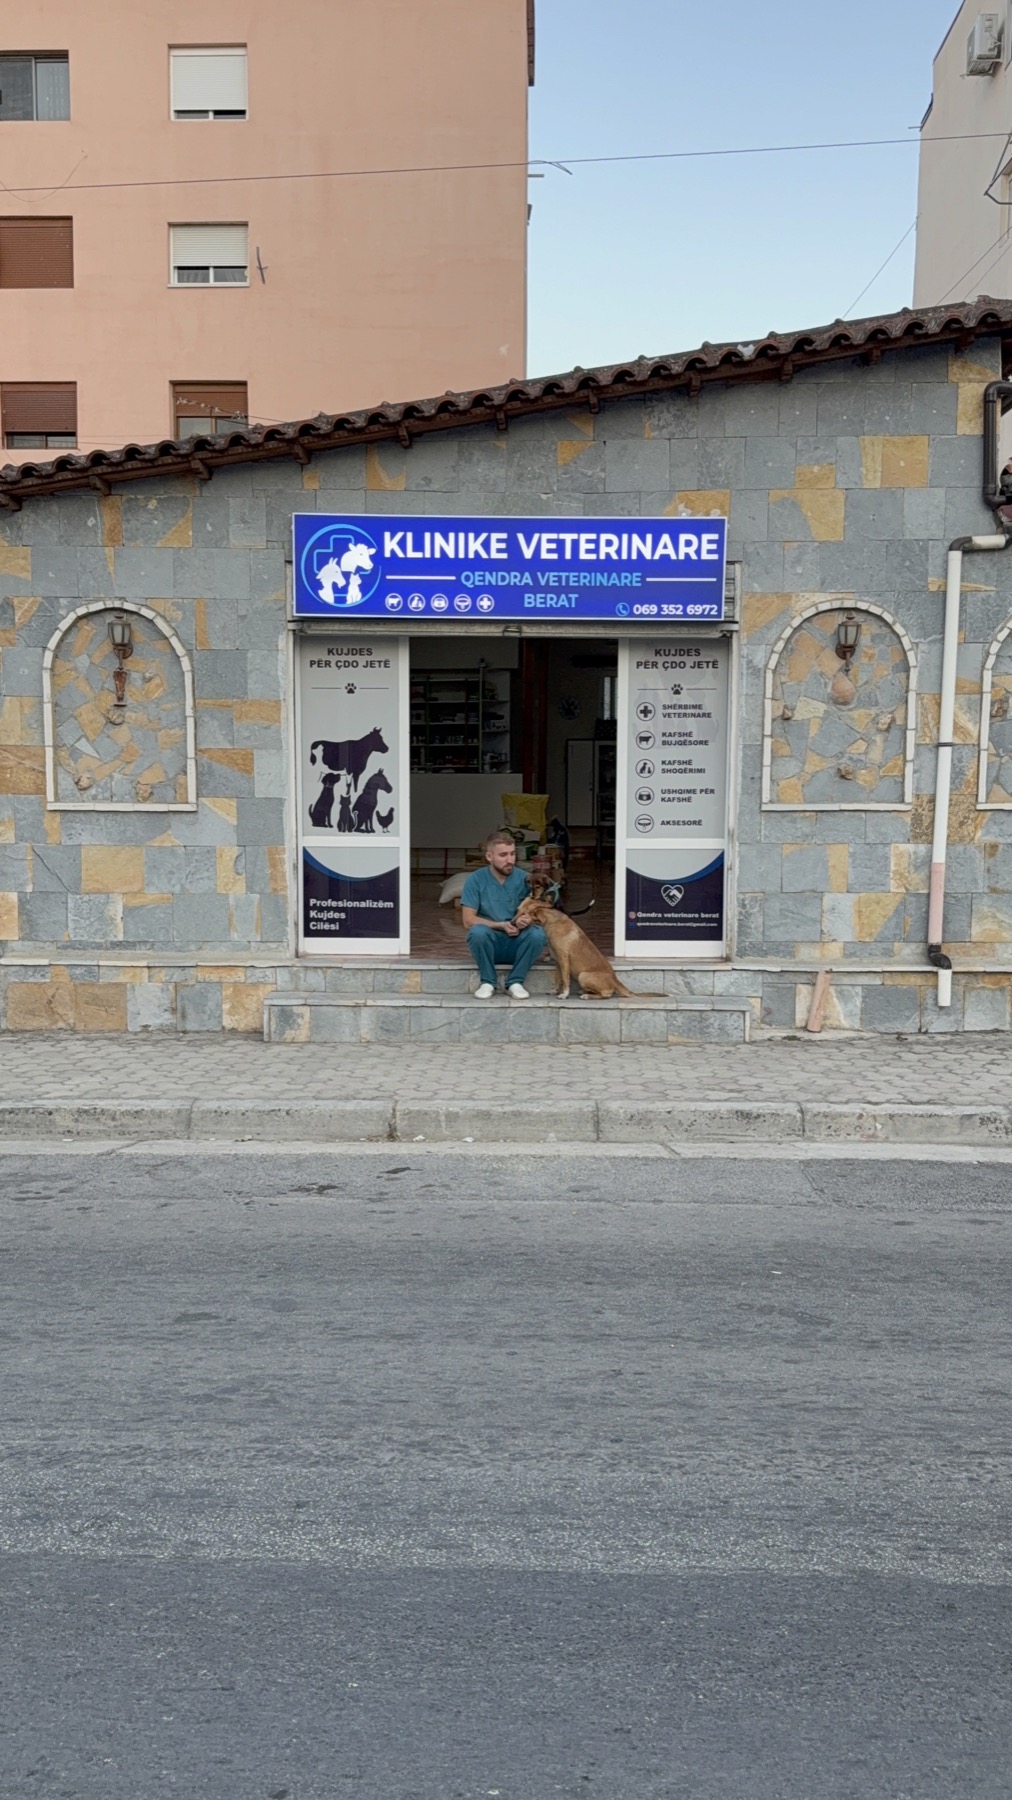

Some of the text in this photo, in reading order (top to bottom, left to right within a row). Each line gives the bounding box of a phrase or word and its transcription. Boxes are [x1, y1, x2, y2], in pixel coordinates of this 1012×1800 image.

[383, 531, 719, 560] KLINIKE VETERINARE
[460, 571, 642, 588] QENDRA VETERINARE
[524, 594, 578, 608] BERAT
[633, 604, 718, 615] 069 352 6972
[327, 647, 373, 656] KUJDES
[654, 648, 701, 657] KUJDES
[309, 658, 391, 670] PËR ÇDO JETË
[636, 659, 719, 671] PËR ÇDO JETË
[309, 898, 394, 908] Profesionalizëm
[309, 910, 346, 920] Kujdes
[309, 921, 339, 930] Cilësi
